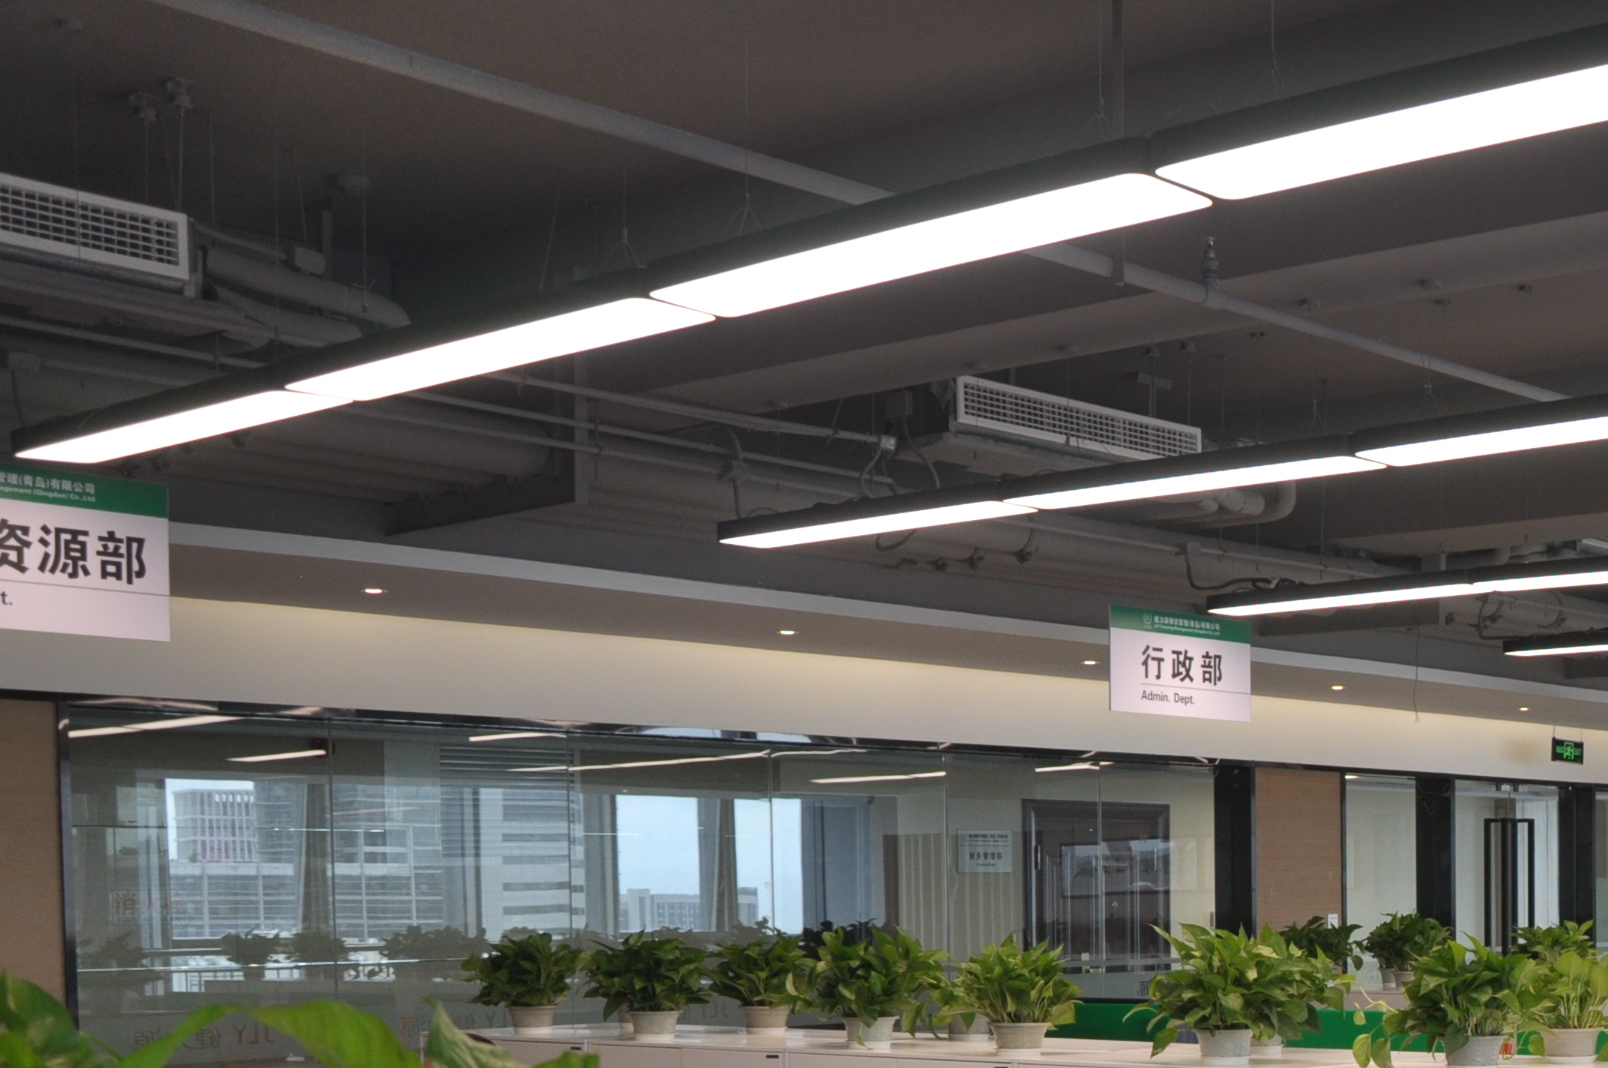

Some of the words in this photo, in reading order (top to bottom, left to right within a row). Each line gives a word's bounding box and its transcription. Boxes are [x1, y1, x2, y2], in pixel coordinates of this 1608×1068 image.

[1141, 644, 1223, 686] 行政部
[1141, 690, 1171, 703] Admin.
[1174, 693, 1195, 706] Dept.
